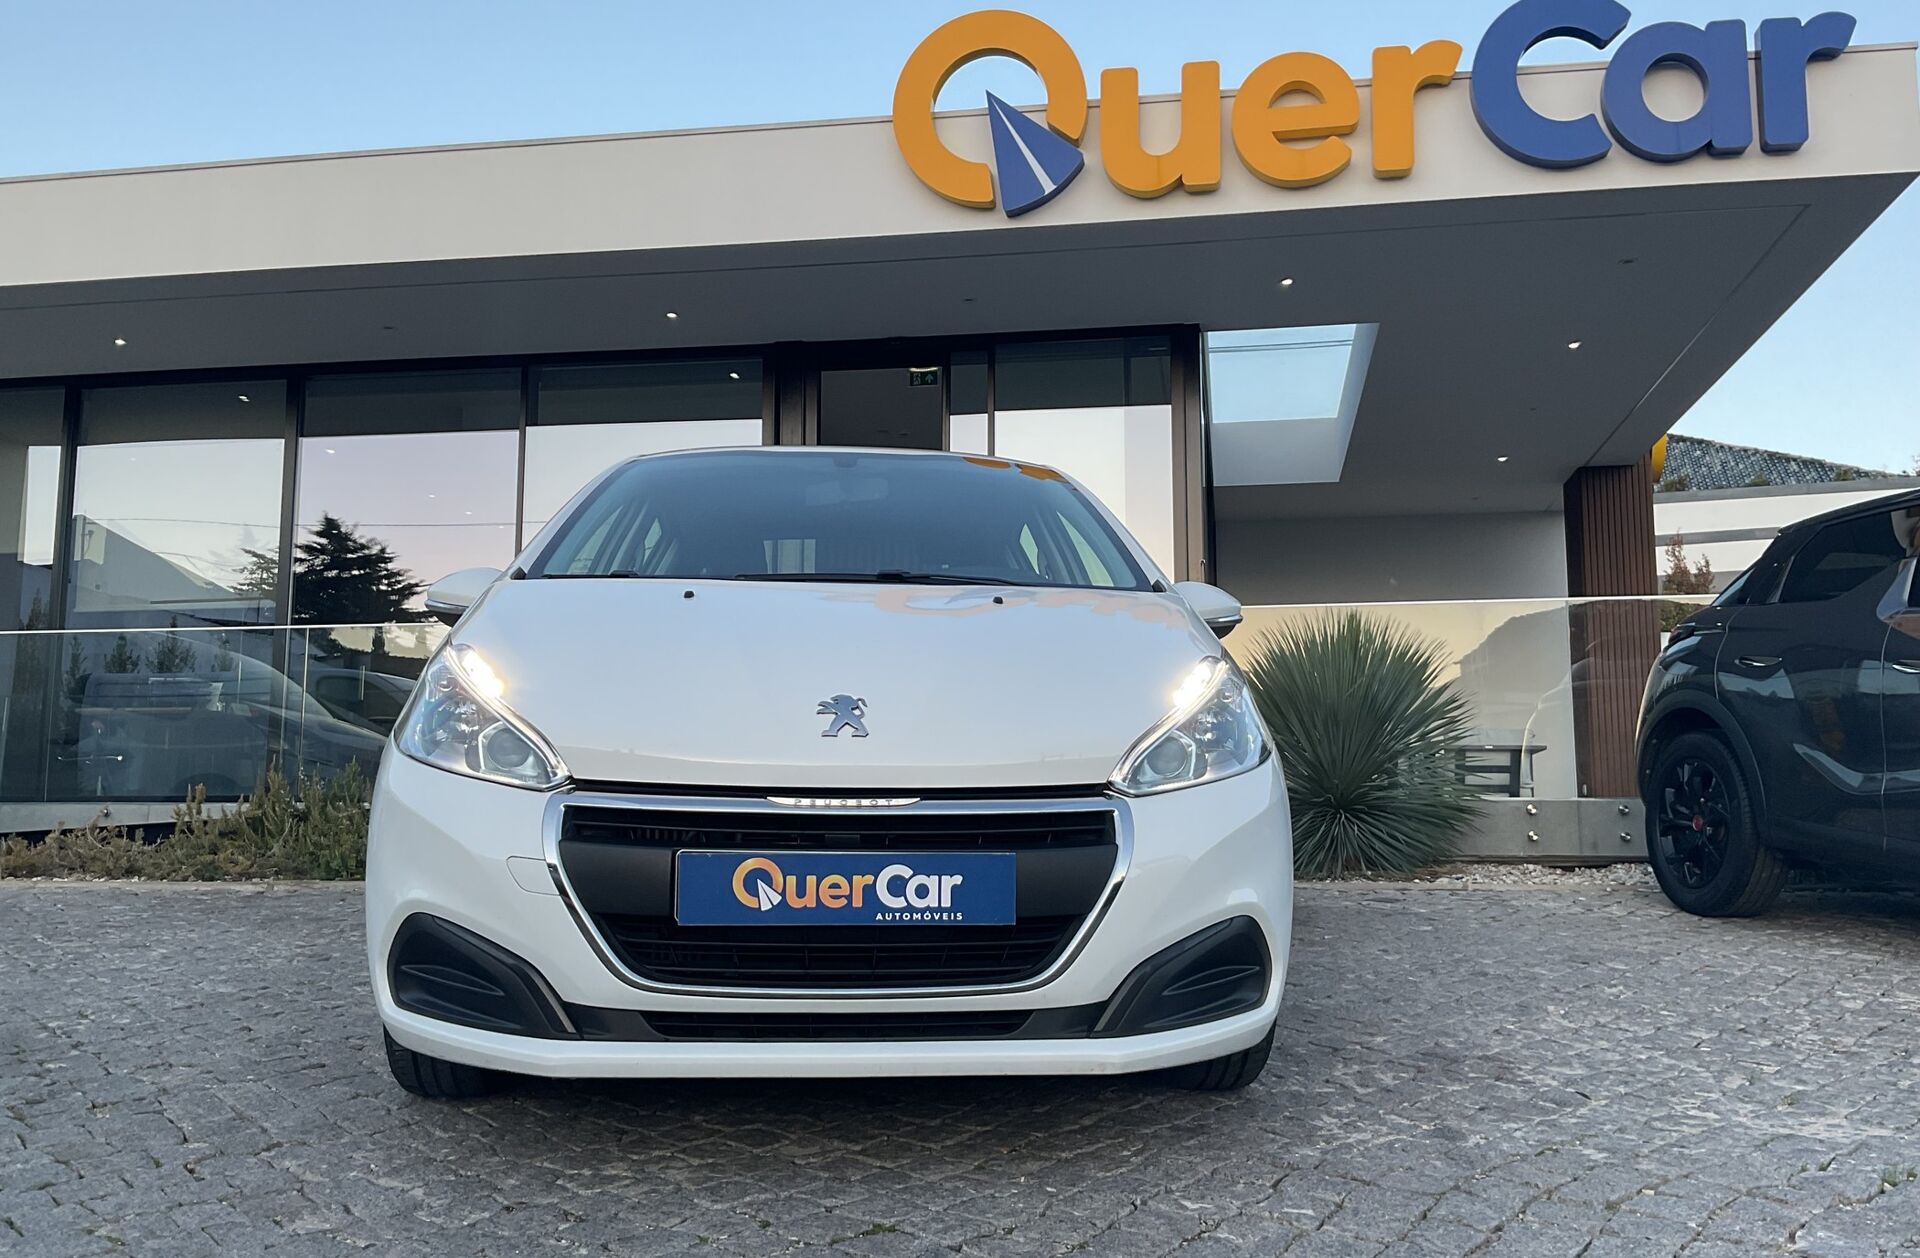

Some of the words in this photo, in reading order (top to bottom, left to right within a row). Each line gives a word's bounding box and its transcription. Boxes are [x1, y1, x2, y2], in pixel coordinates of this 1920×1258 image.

[892, 0, 1857, 218] QuerCar
[732, 857, 964, 912] QuerCar
[875, 911, 964, 921] AUTOMÓVEIS
